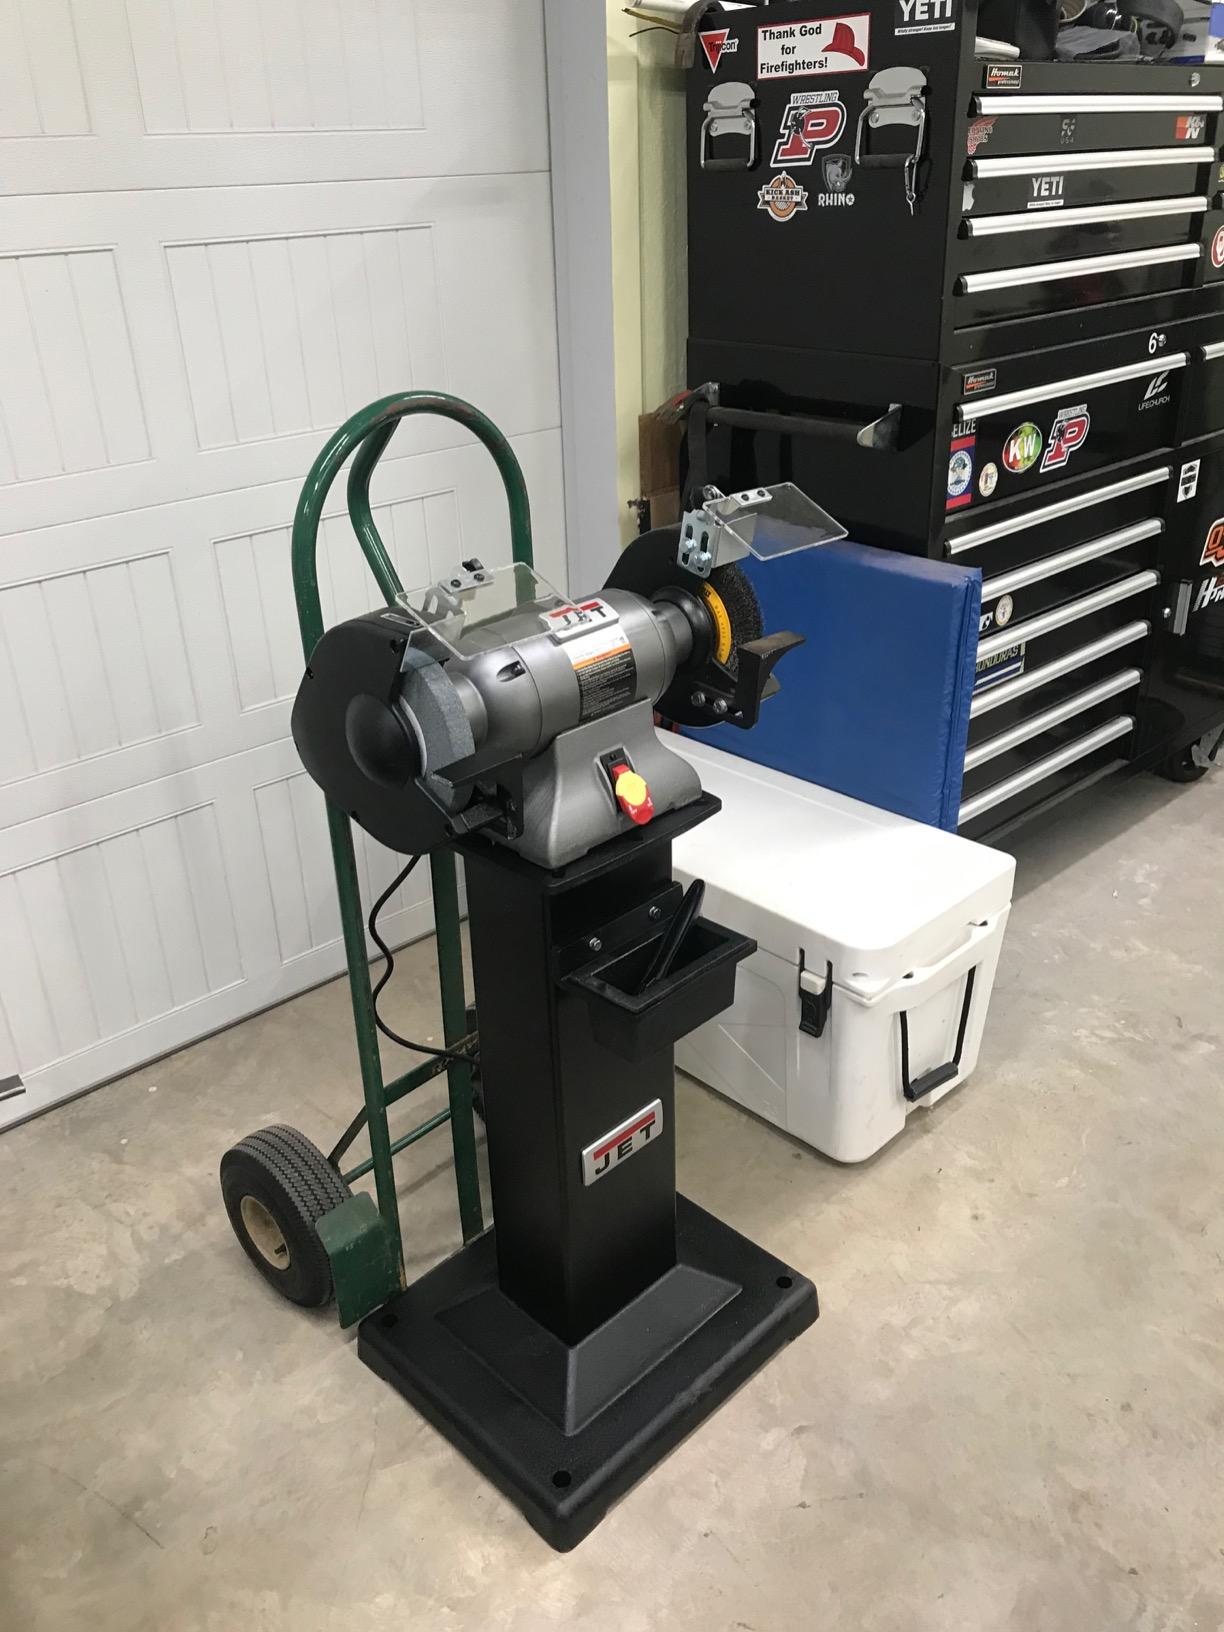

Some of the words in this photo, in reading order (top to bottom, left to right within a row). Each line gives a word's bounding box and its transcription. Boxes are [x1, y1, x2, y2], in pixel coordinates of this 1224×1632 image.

[899, 0, 953, 21] YETI
[761, 27, 796, 41] Thank
[799, 23, 822, 36] God
[780, 44, 797, 55] for
[760, 57, 828, 74] Firefighters!
[792, 92, 838, 105] WRESTLING
[765, 187, 781, 196] KICK
[785, 188, 800, 196] ASH
[1032, 176, 1064, 197] YETI
[818, 193, 855, 207] RHINO
[951, 418, 977, 438] ELIZE
[1009, 434, 1037, 463] KW
[561, 605, 607, 626] JET
[595, 1119, 656, 1175] JET
